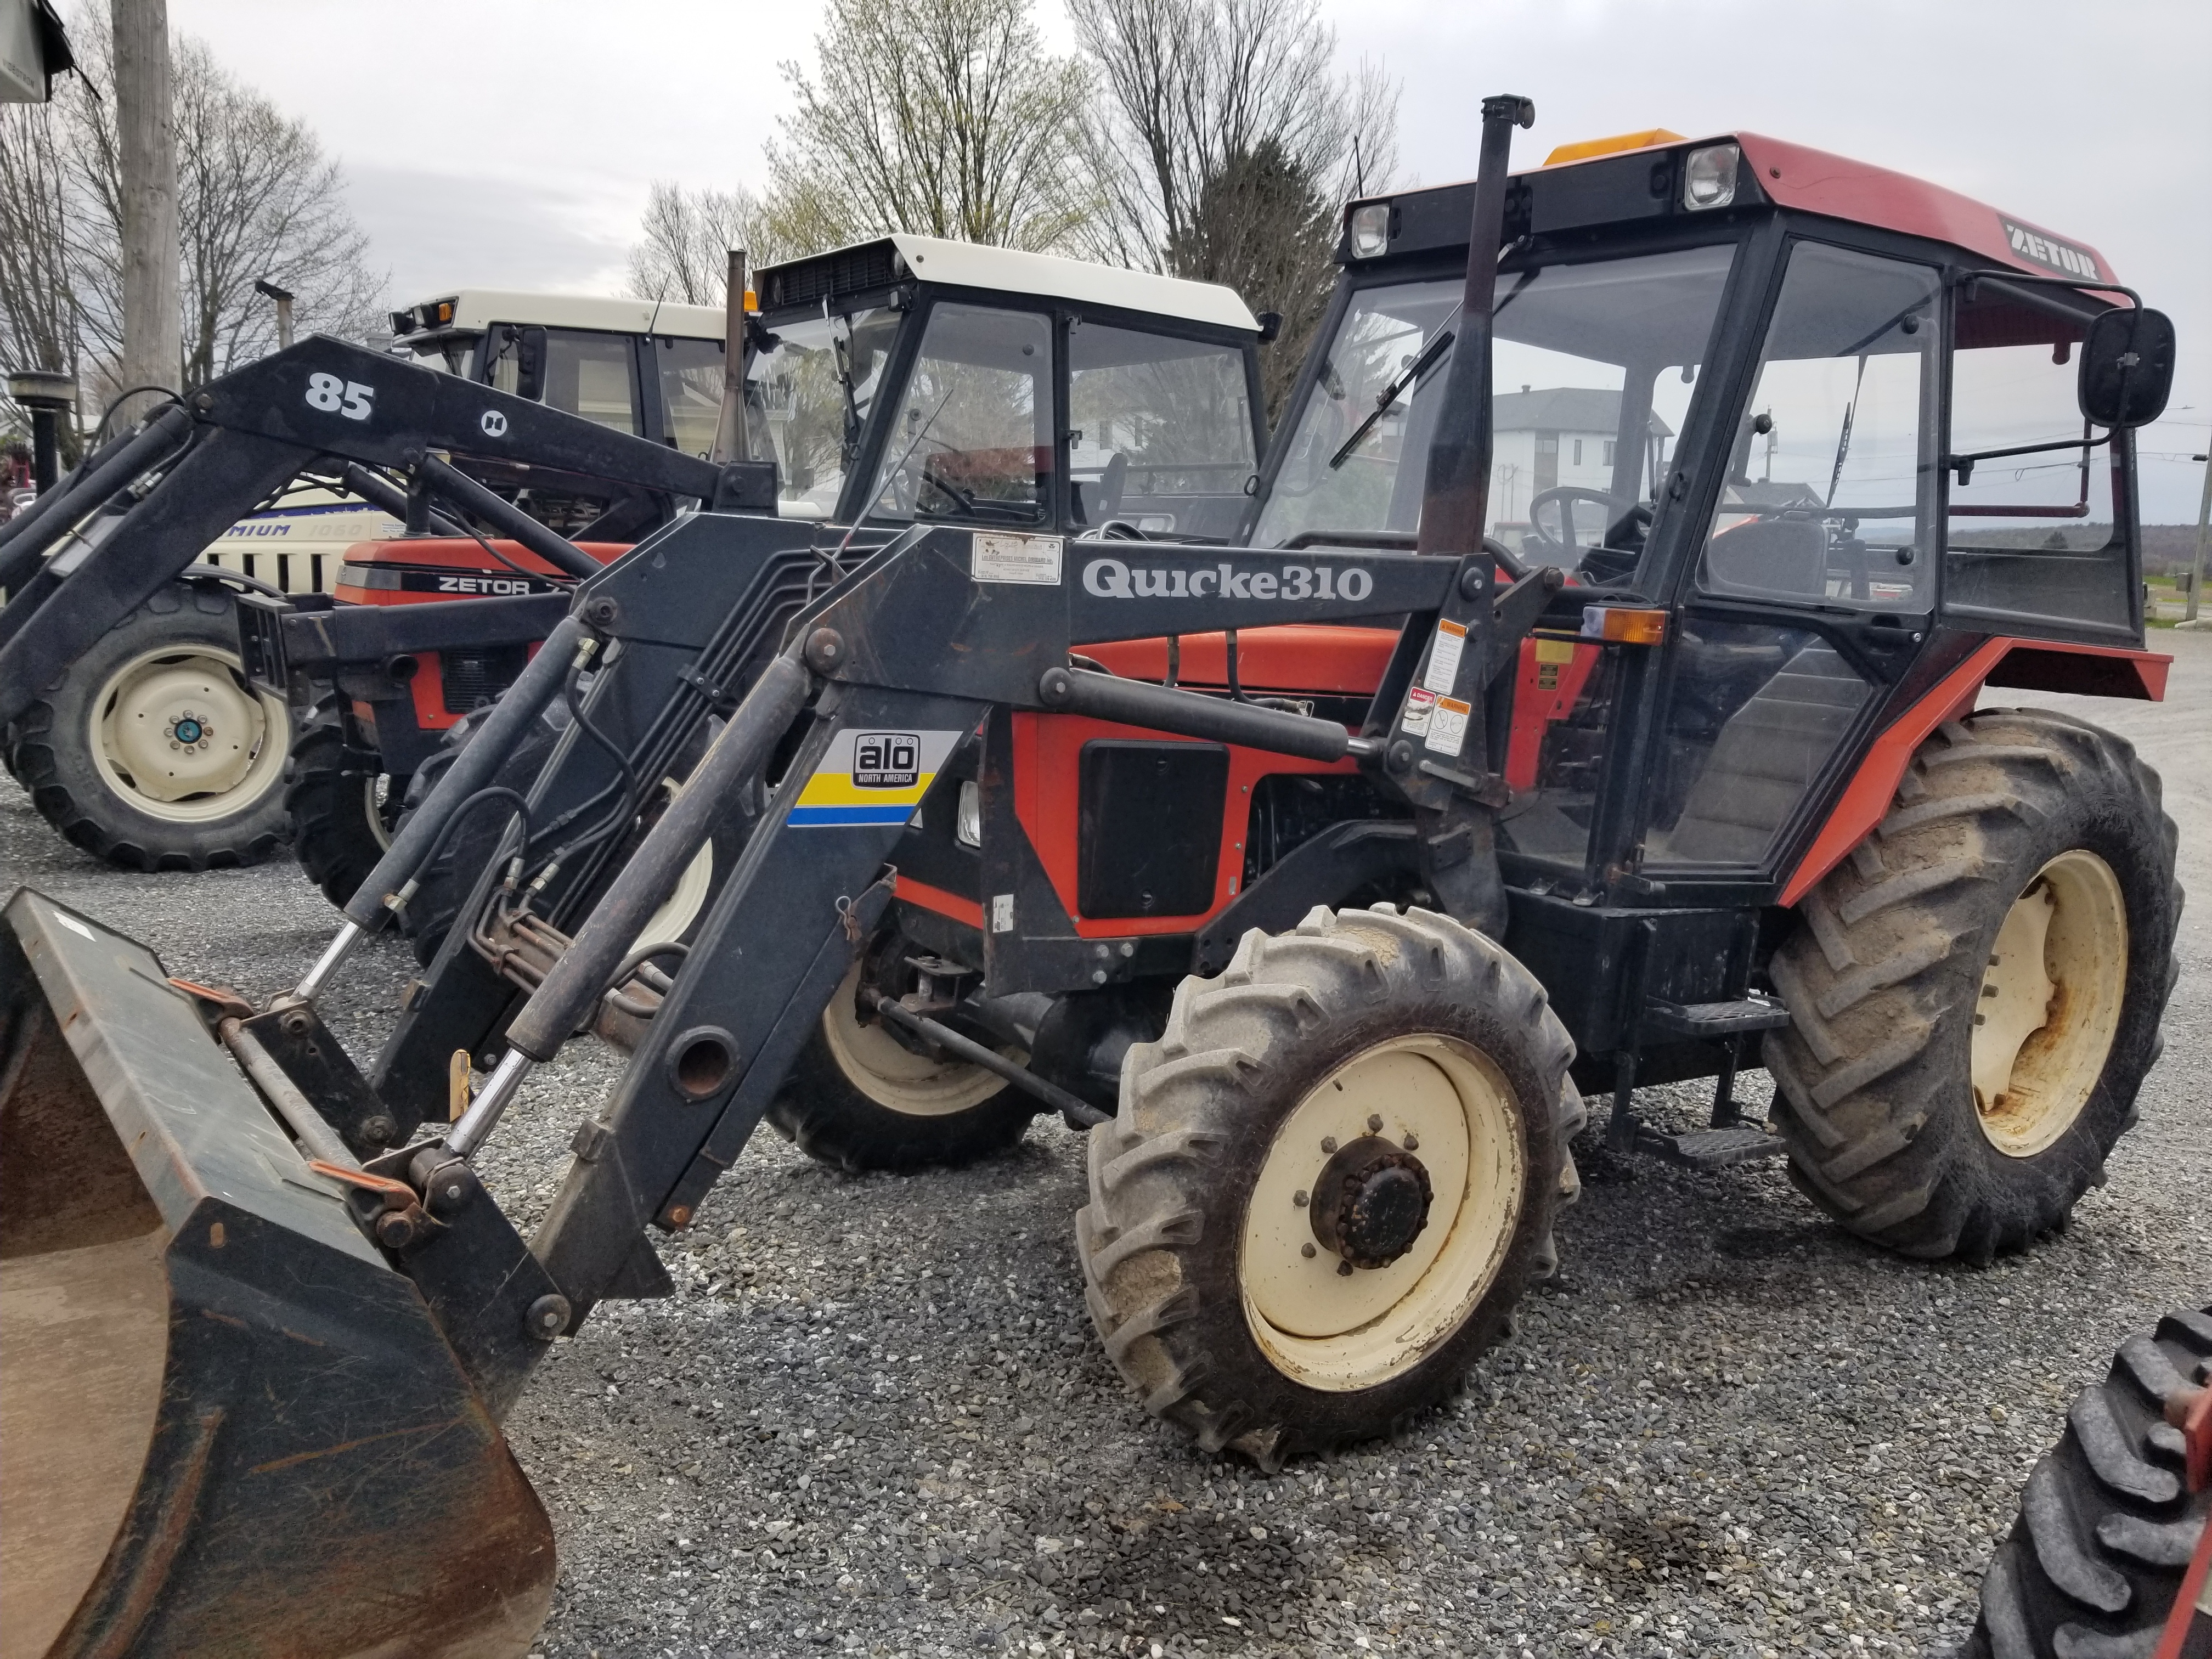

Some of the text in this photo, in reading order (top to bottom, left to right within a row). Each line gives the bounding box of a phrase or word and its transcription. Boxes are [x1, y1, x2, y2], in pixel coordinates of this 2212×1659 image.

[2006, 224, 2098, 280] ZETOR
[305, 372, 374, 420] 85
[228, 524, 291, 537] MIUM
[439, 577, 530, 595] ZETOR
[1446, 625, 1464, 636] WARNING
[1447, 701, 1466, 712] WARNING
[859, 774, 912, 783] NORTH AMERICA
